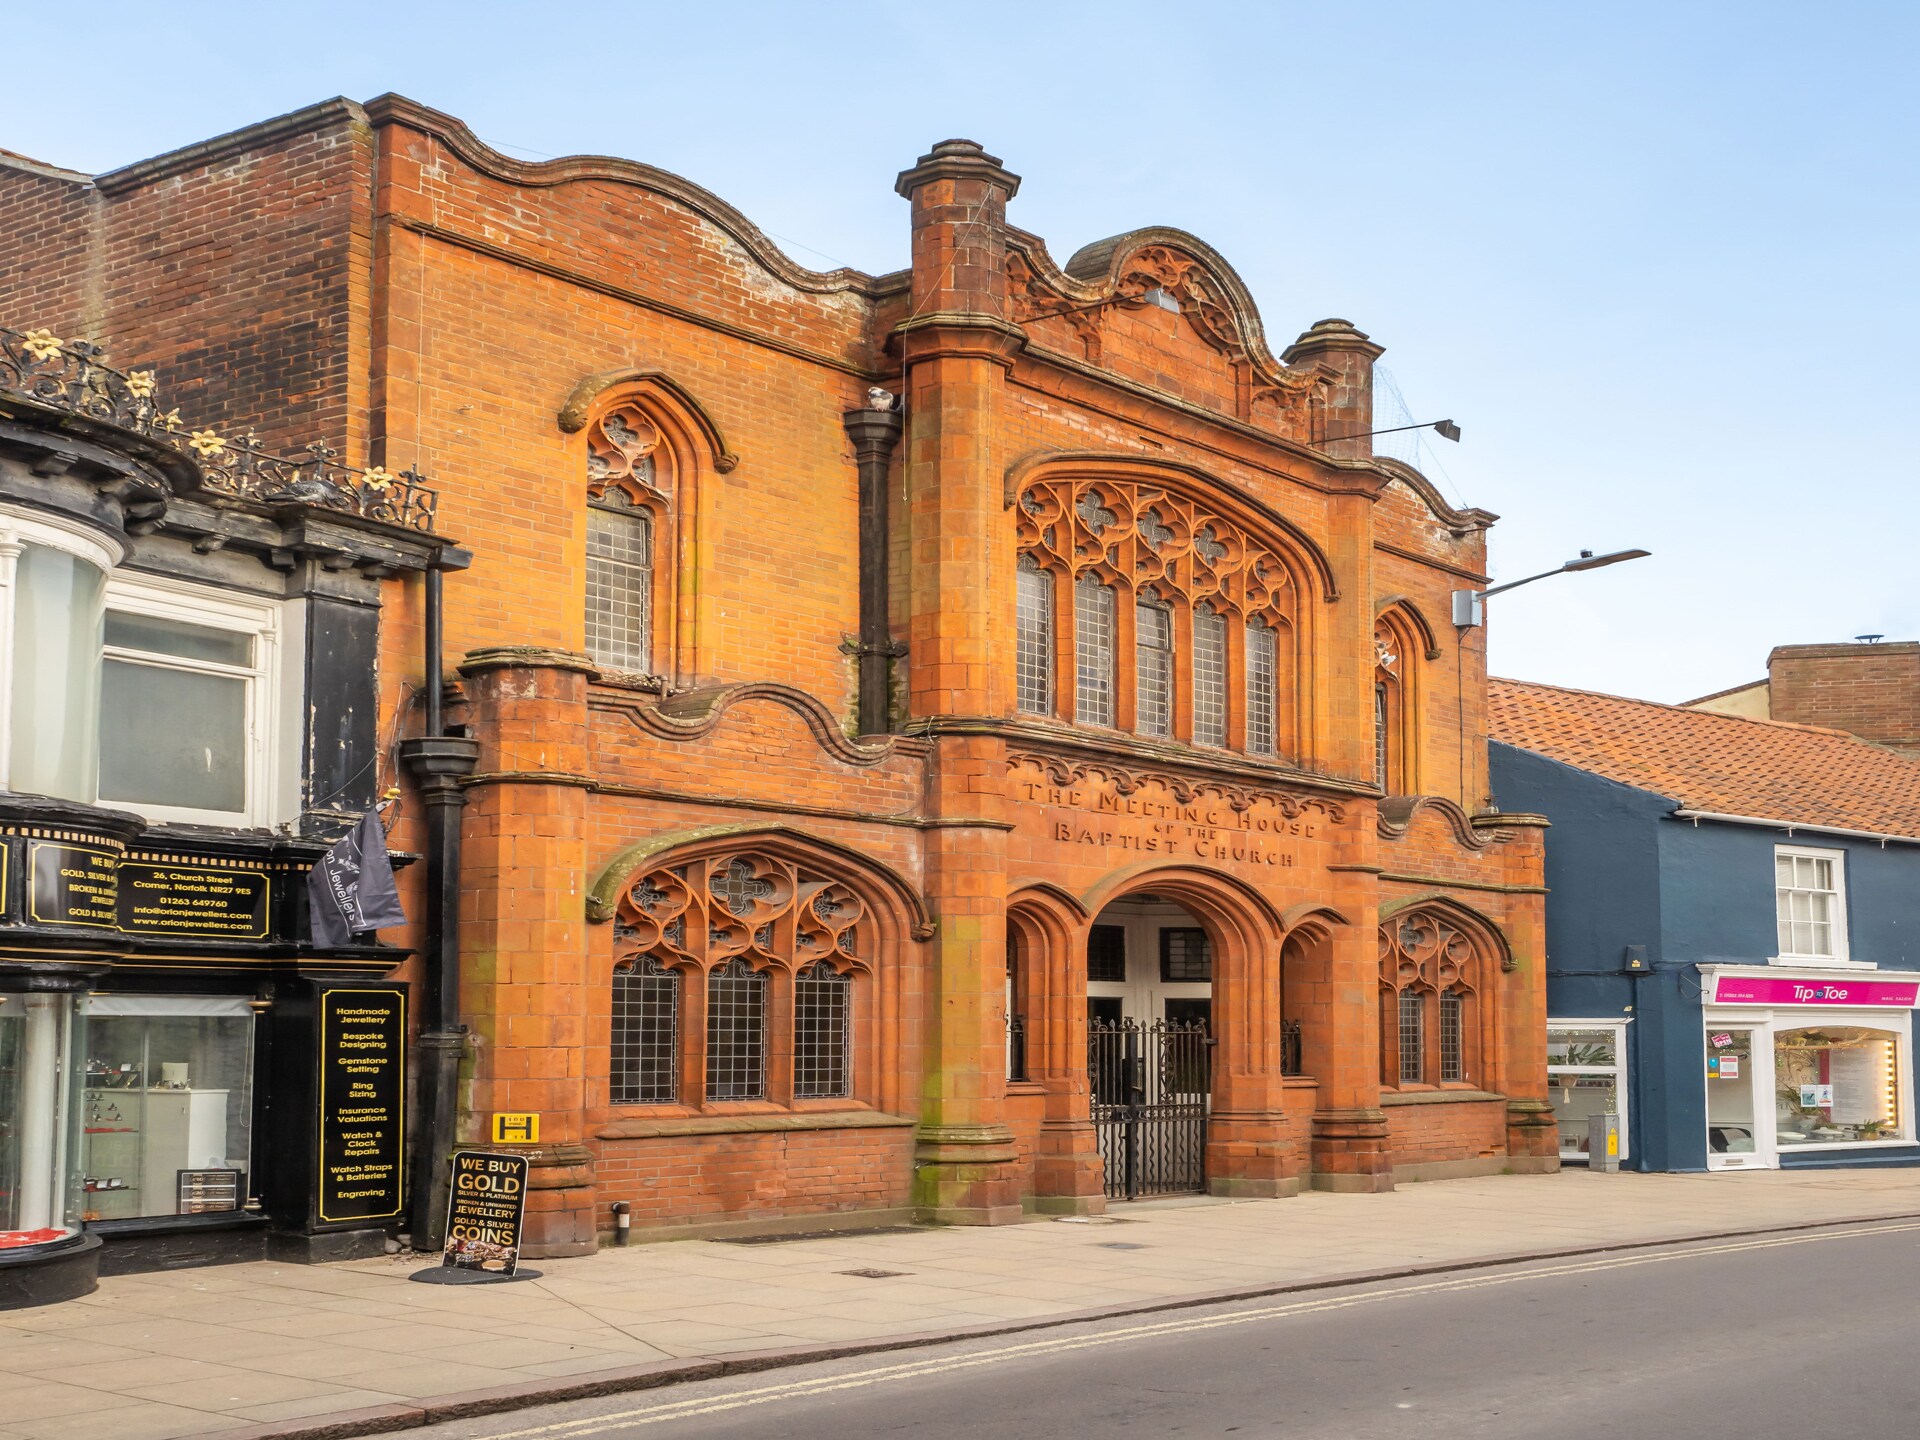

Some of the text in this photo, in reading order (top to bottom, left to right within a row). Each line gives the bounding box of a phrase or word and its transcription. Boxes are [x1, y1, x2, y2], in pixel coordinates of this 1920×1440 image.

[1023, 782, 1315, 839] THE MEETING HOUSE
[1186, 826, 1216, 841] THE
[1055, 822, 1294, 868] BAPTIST CHURCH
[91, 856, 102, 867] WE
[169, 873, 204, 883] Church
[206, 875, 233, 884] Street
[68, 884, 97, 894] BROKEN
[174, 884, 208, 893] Norfolk
[210, 886, 233, 895] NR27
[235, 887, 252, 896] 9ES
[330, 869, 355, 921] Jewellers
[159, 897, 228, 908] 01263 649760
[68, 908, 90, 917] GOLD
[134, 906, 252, 920] info@orionjewellers.com
[133, 918, 253, 931] www.orionjewellers.com
[1793, 985, 1814, 1002] Tip
[1823, 986, 1848, 1000] Toe
[340, 1016, 386, 1024] Jewellery
[342, 1033, 384, 1041] Bespoke
[339, 1041, 387, 1050] Designing
[346, 1066, 380, 1074] Setting
[352, 1082, 374, 1091] Ring
[349, 1090, 377, 1099] Sizing
[338, 1107, 387, 1115] Insurance
[337, 1115, 388, 1123] Valuations
[342, 1132, 373, 1140] Watch
[348, 1140, 377, 1148] Clock
[344, 1148, 380, 1157] Repairs
[330, 1163, 393, 1174] Watch Straps
[461, 1158, 521, 1174] WE BUY
[336, 1172, 387, 1182] & Batteries
[458, 1173, 520, 1194] GOLD
[337, 1188, 386, 1199] Engraving
[458, 1190, 479, 1198] SILVER
[485, 1191, 518, 1201] PLATINUM
[455, 1205, 516, 1219] JEWELLERY
[454, 1217, 515, 1229] GOLD & SILVER
[452, 1225, 514, 1245] COINS
